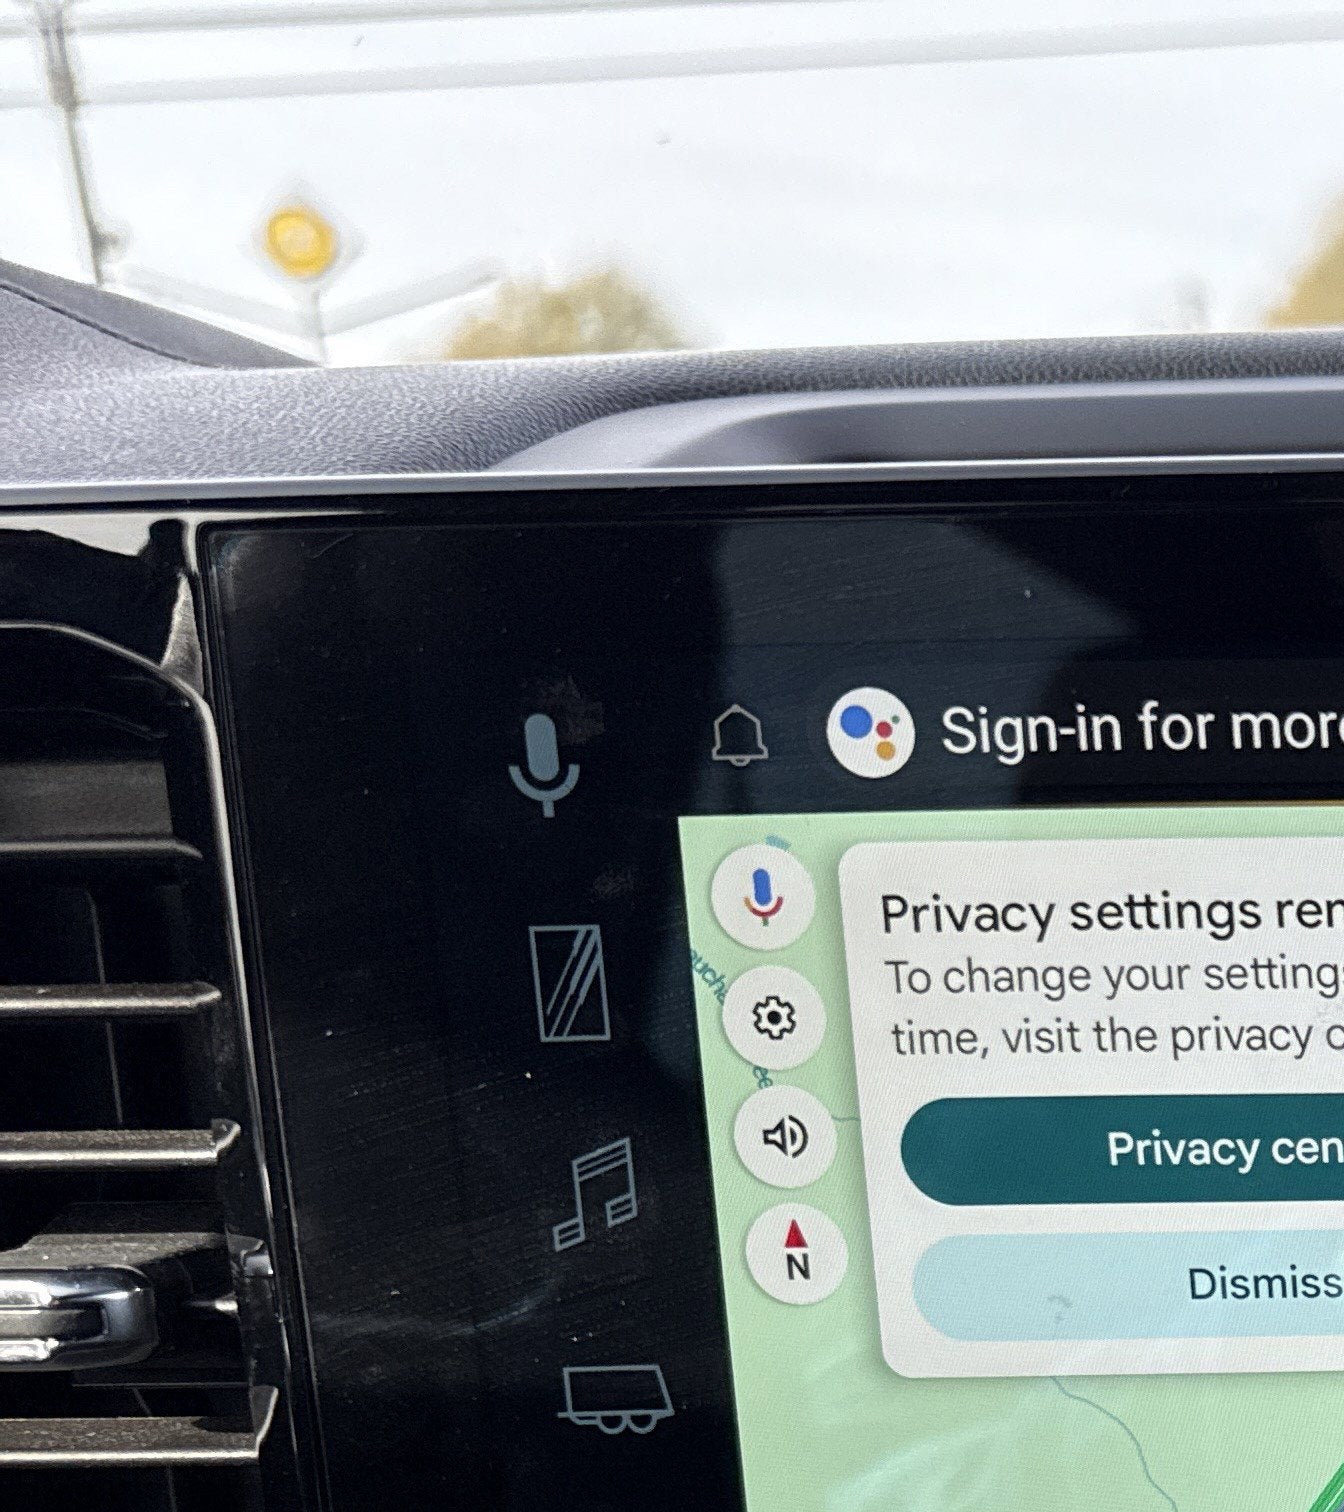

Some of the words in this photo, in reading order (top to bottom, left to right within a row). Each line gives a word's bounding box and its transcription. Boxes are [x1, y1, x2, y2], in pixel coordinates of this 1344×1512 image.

[941, 704, 1123, 765] Sign-in
[1139, 699, 1214, 752] for
[881, 892, 1055, 942] Privacy
[1070, 889, 1262, 940] settings
[886, 958, 931, 995] To
[943, 956, 1092, 1005] change
[1103, 963, 1190, 1005] your
[891, 1019, 990, 1062] time,
[1002, 1019, 1082, 1055] visit
[1094, 1017, 1159, 1053] the
[1171, 1018, 1312, 1062] privacy
[1107, 1127, 1260, 1175] Privacy
[785, 1252, 811, 1282] N
[1189, 1263, 1344, 1302] Dismiss
